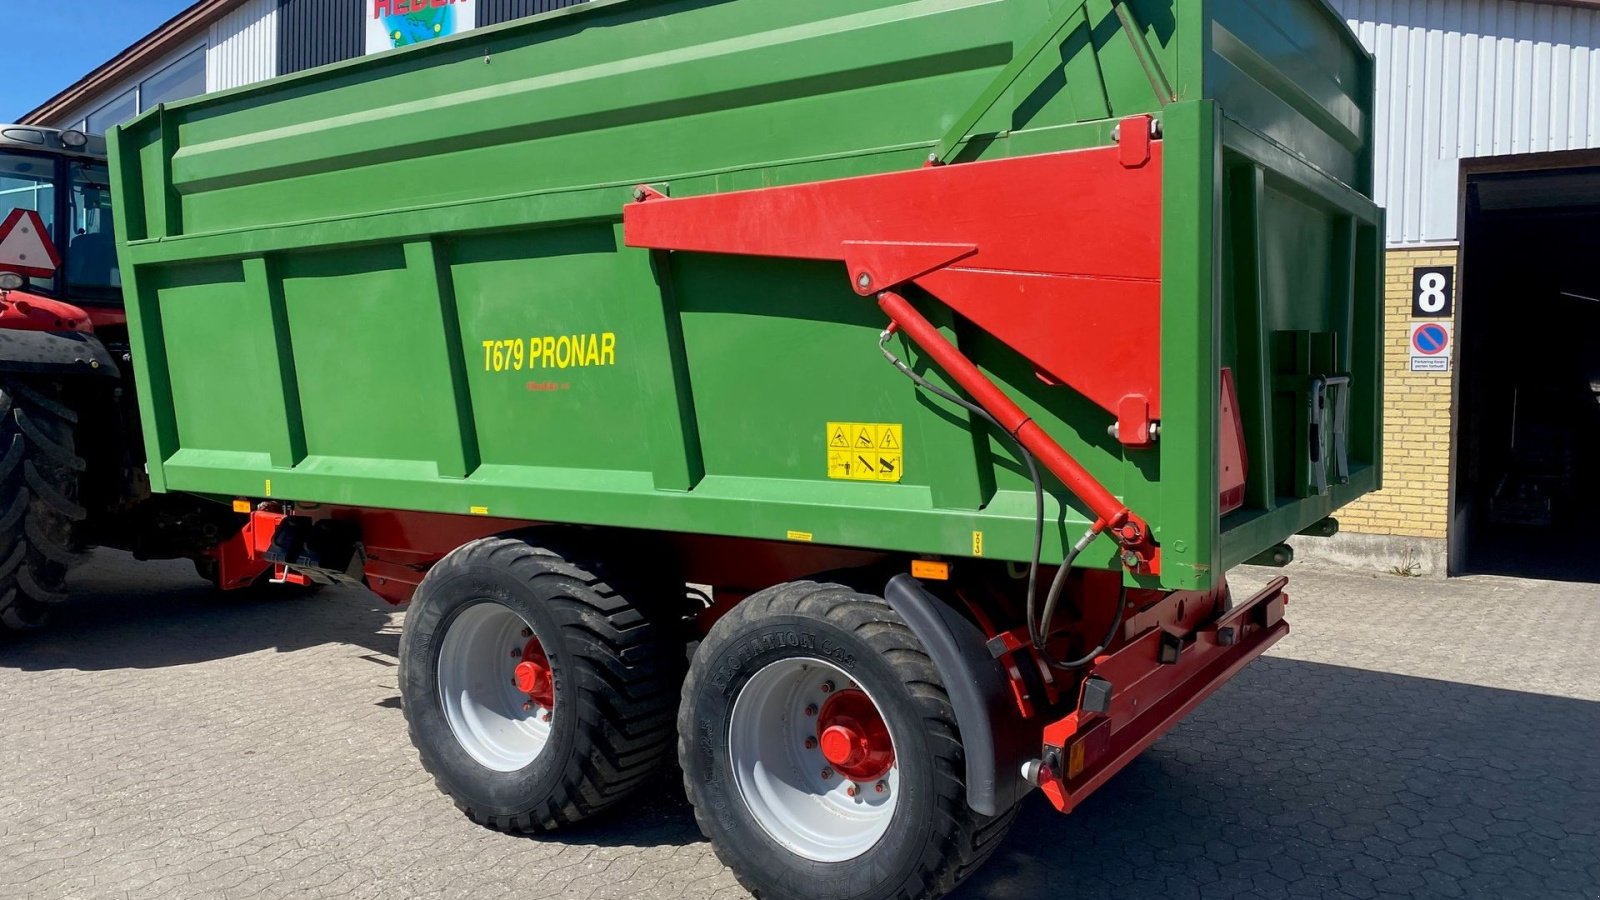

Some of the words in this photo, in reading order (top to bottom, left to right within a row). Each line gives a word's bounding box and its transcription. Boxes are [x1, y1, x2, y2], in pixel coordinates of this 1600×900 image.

[1419, 272, 1446, 313] 8
[482, 338, 524, 372] T679
[529, 332, 616, 369] PRONAR
